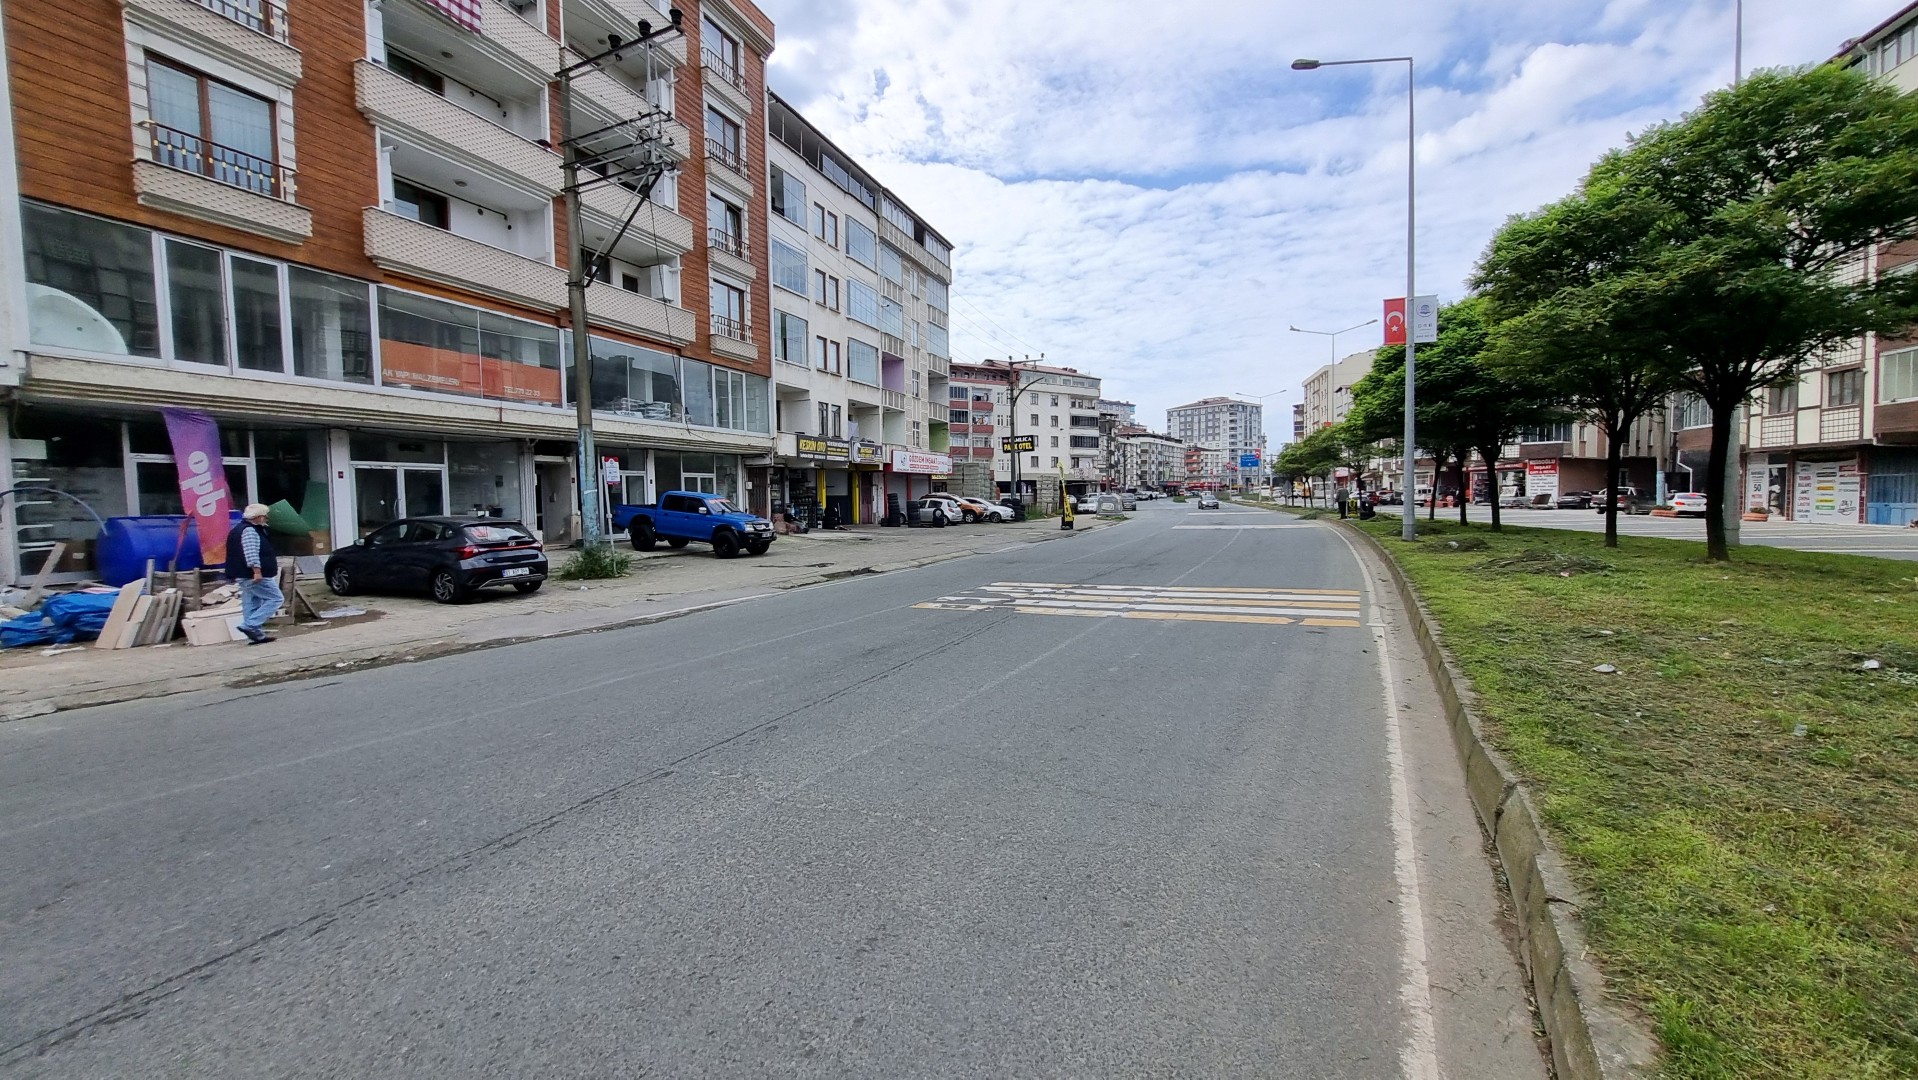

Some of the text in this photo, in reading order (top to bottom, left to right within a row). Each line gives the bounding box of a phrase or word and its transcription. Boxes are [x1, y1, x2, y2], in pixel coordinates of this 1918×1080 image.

[382, 368, 393, 377] AK
[816, 441, 827, 452] OTO
[1003, 442, 1033, 451] PAK OTEL
[1753, 484, 1761, 492] 50
